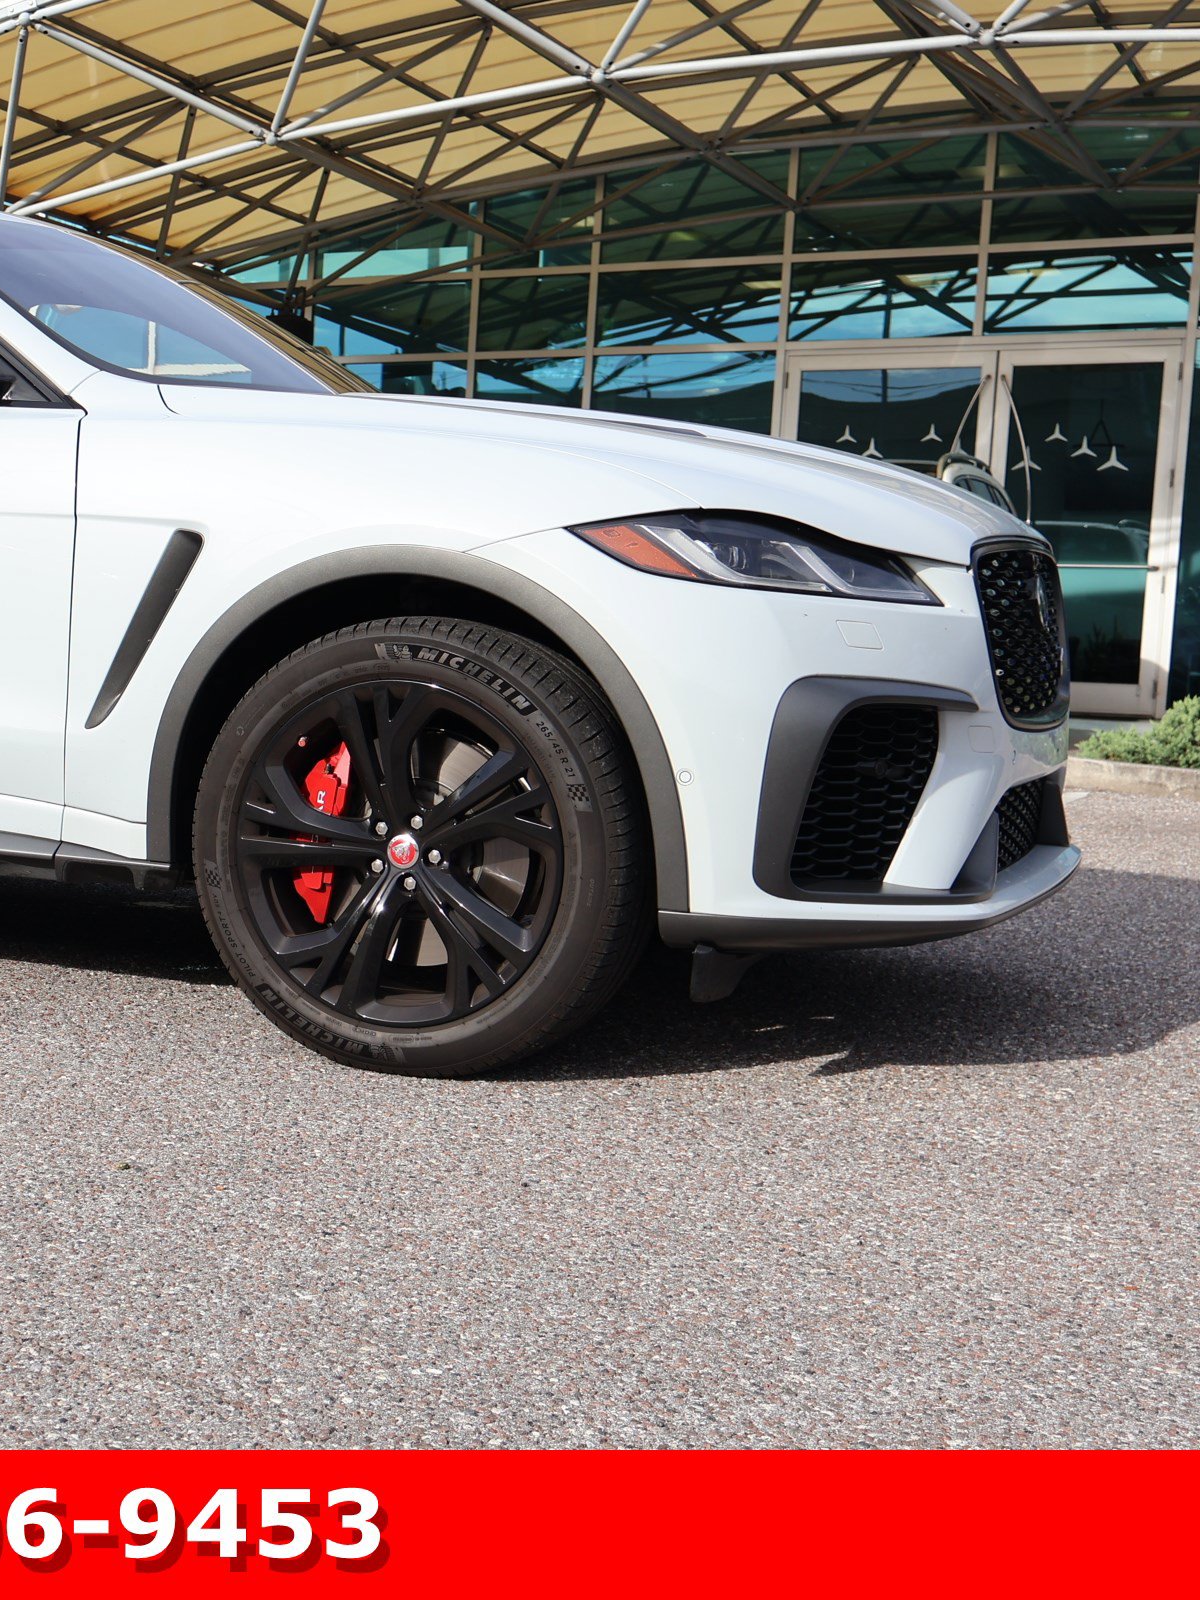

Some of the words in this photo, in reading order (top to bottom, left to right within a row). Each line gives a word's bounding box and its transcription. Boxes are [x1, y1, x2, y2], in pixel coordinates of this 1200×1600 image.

[417, 647, 531, 710] MICHELIN
[536, 721, 563, 755] 265/45
[560, 756, 569, 765] R
[565, 766, 576, 778] 21
[234, 953, 256, 980] PILOT
[260, 989, 364, 1055] MICHELIN
